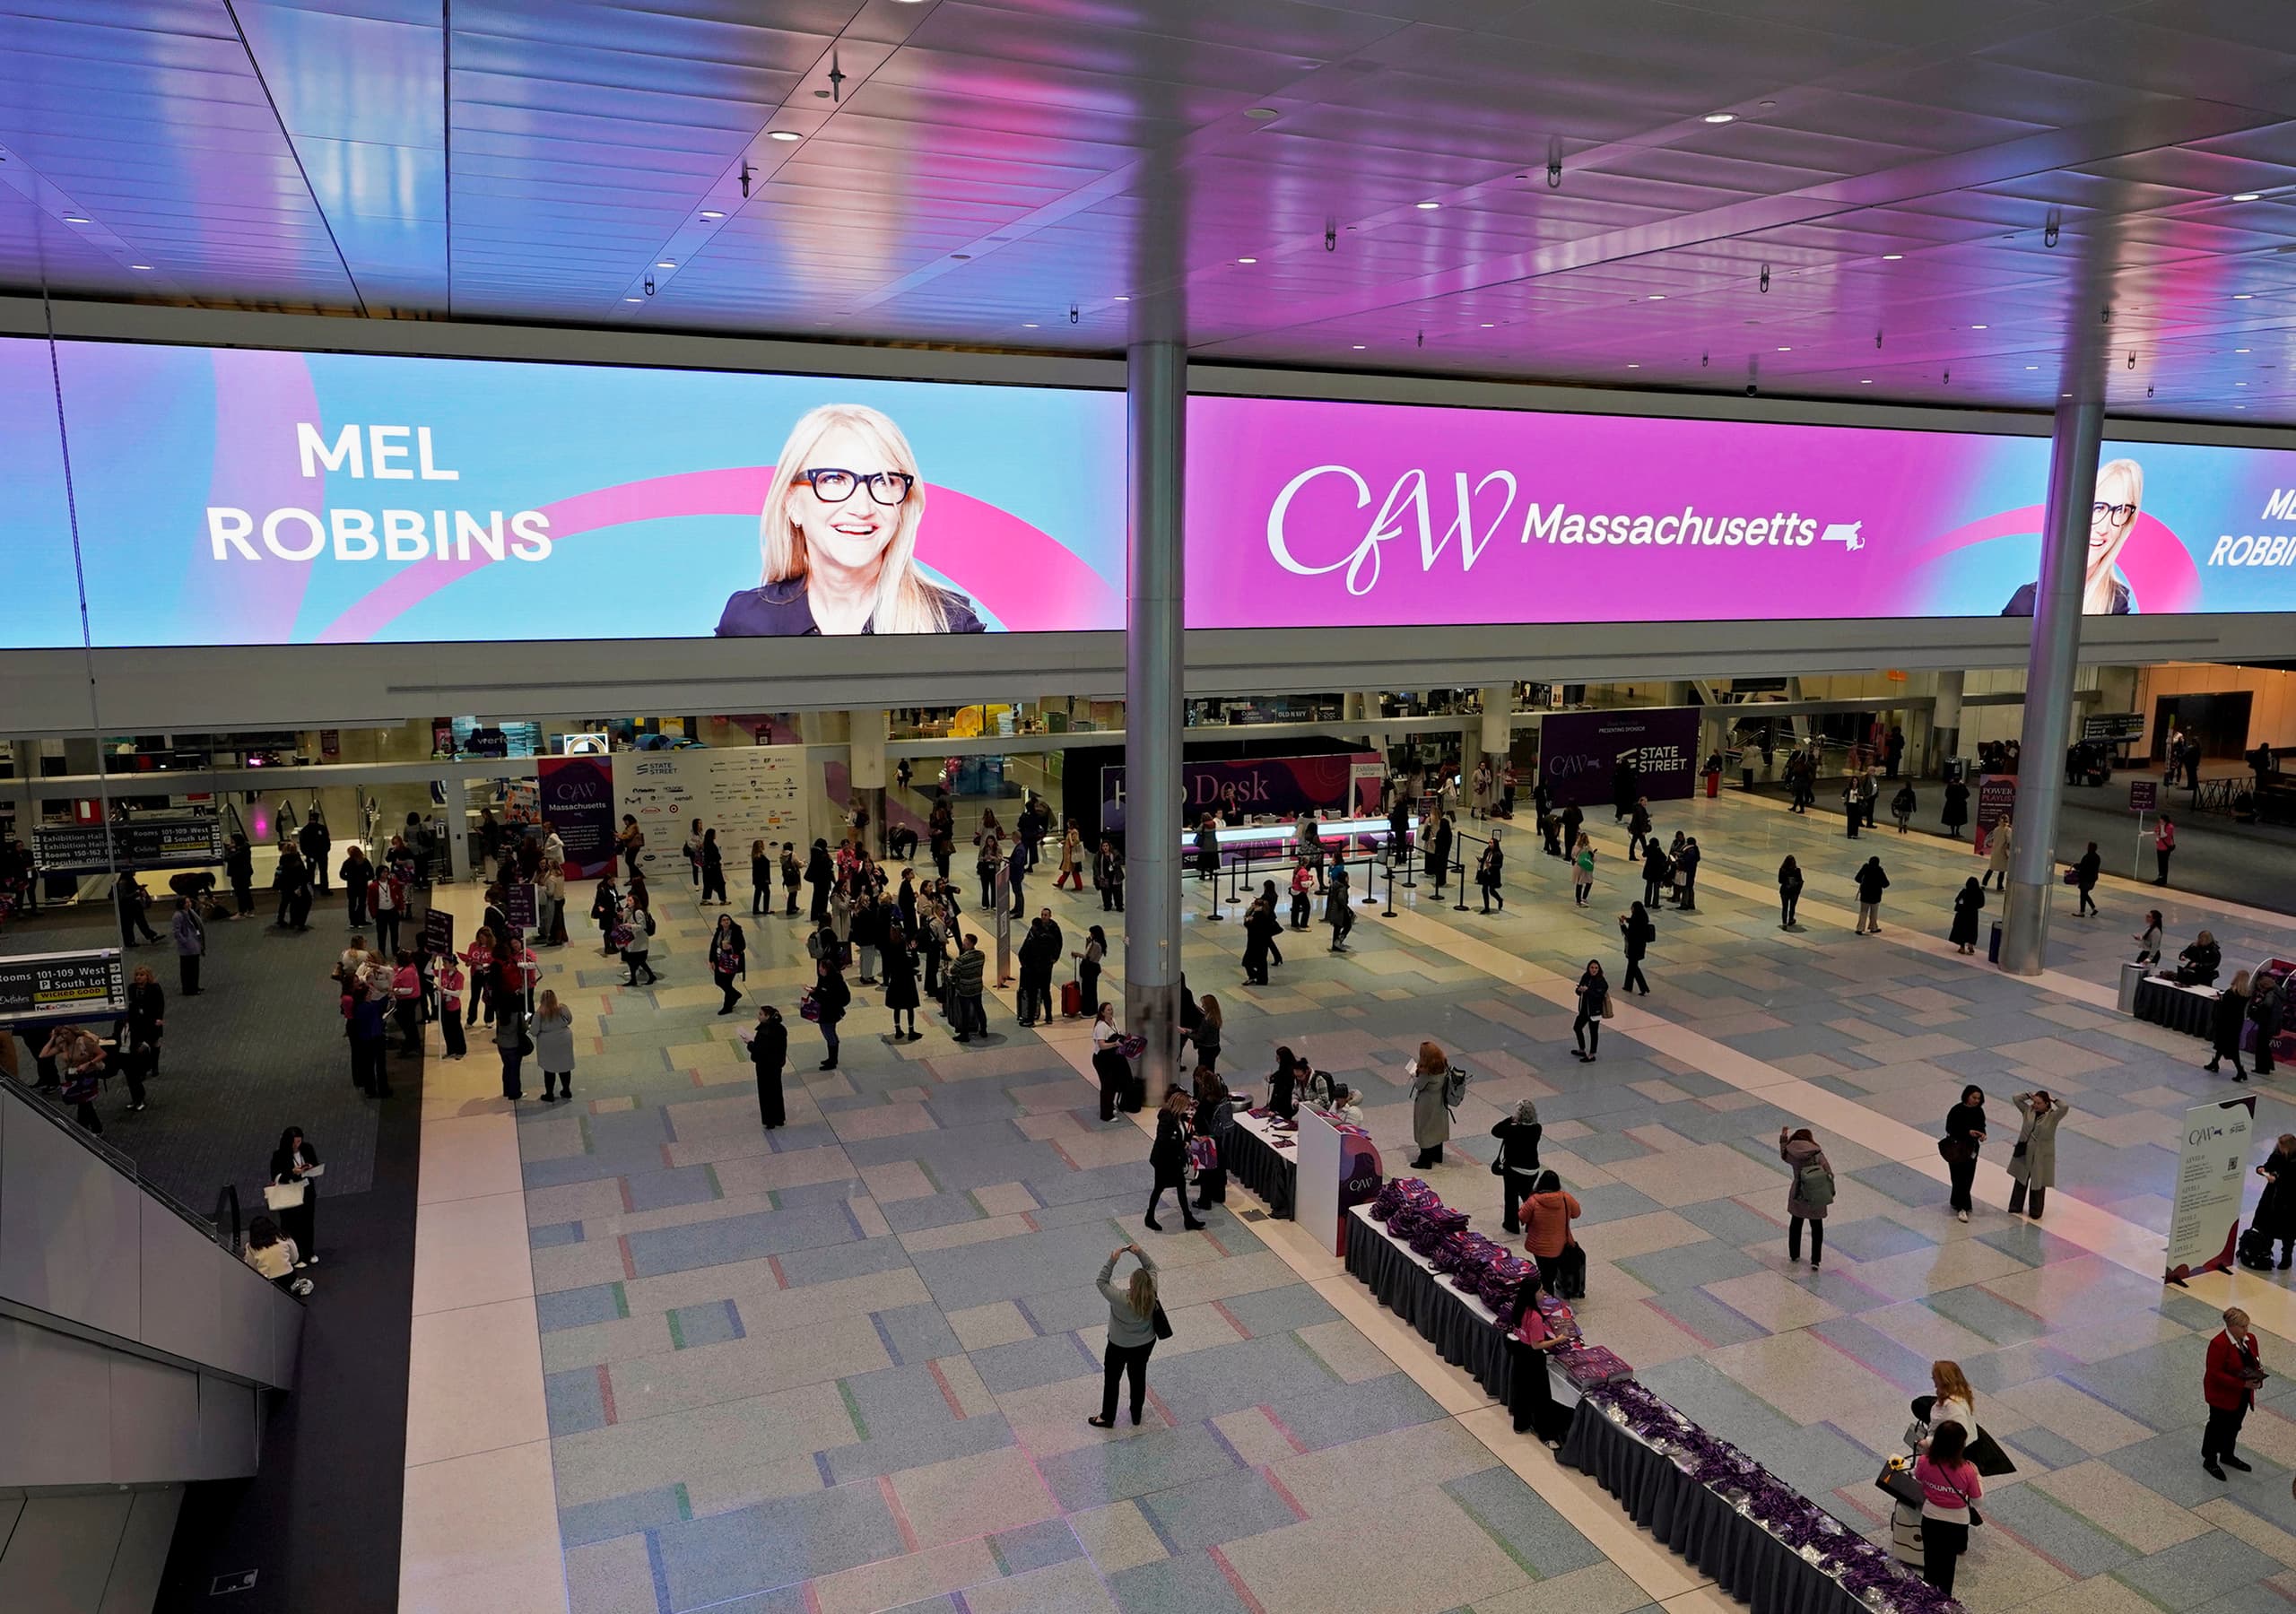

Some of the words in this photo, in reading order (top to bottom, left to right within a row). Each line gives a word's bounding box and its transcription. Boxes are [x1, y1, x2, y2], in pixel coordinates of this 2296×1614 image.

[297, 422, 460, 481] MEL
[2261, 488, 2296, 520] ME
[1520, 502, 1818, 546] Massachusetts
[206, 507, 552, 562] ROBBINS
[2207, 534, 2296, 567] ROBBI
[1639, 745, 1679, 759] STATE
[1194, 769, 1271, 805] Desk
[548, 802, 607, 811] Massachusetts
[42, 834, 85, 843] Exhibition
[43, 841, 86, 850] Exhibition
[36, 968, 74, 980] 101-109
[78, 967, 106, 976] West
[55, 978, 86, 990] South
[90, 977, 107, 986] Lot
[41, 989, 75, 999] WICKED
[77, 987, 101, 995] GOOD
